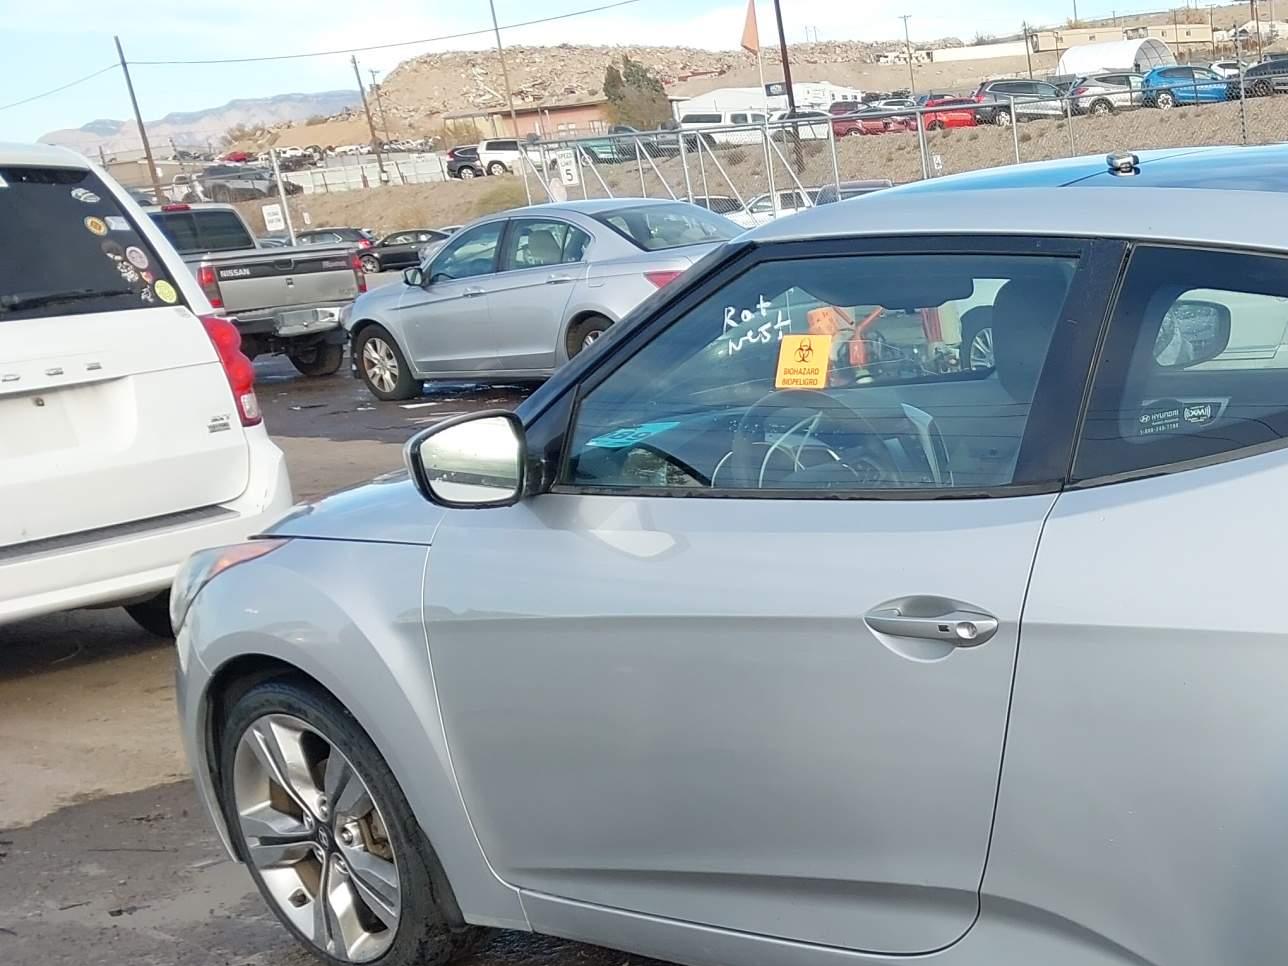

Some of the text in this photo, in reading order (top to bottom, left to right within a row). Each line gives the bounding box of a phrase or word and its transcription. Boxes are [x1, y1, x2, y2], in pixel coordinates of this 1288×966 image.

[565, 168, 574, 182] 5
[219, 268, 250, 278] NISSAN
[783, 367, 820, 376] BIOHAZARD
[781, 378, 818, 386] BIOPELIGRO
[1151, 409, 1179, 421] HYUNDAI
